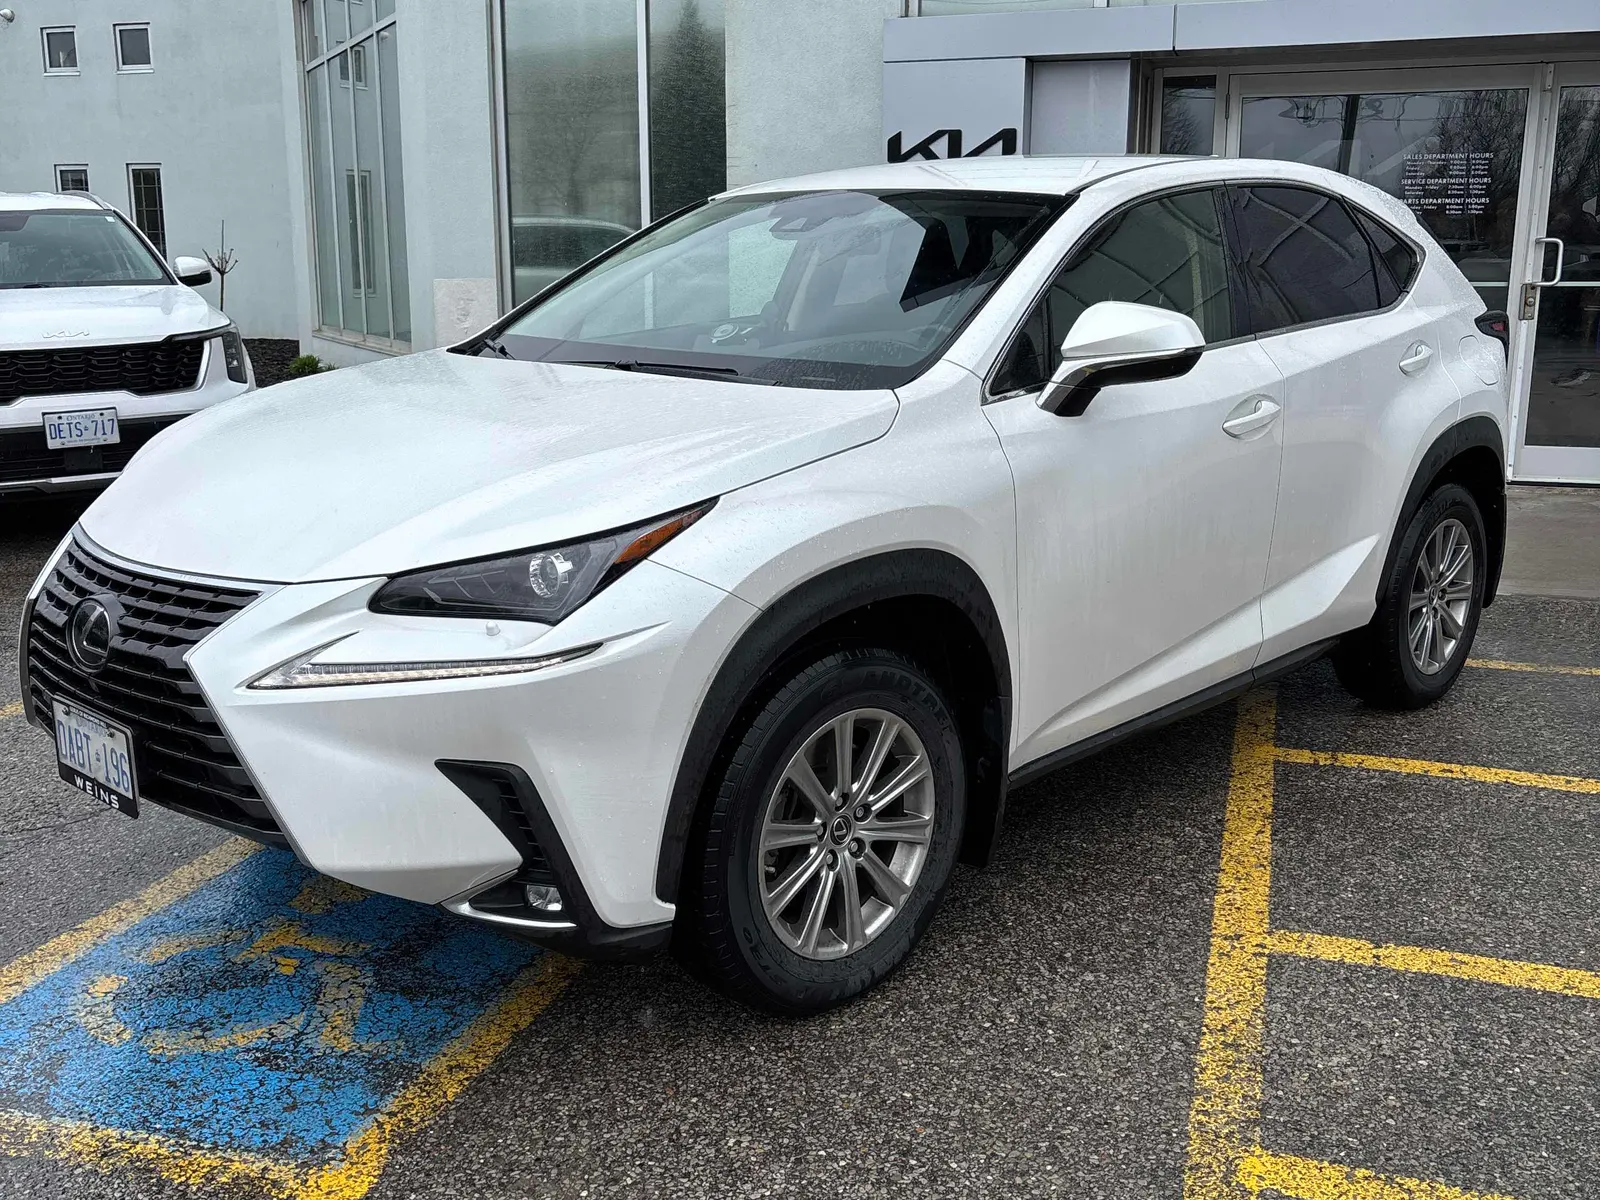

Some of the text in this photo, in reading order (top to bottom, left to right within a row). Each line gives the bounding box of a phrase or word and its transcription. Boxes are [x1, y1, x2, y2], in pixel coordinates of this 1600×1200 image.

[887, 128, 1017, 164] KIA
[48, 418, 115, 440] DETS 717
[66, 414, 96, 422] ONTARIO
[57, 719, 130, 793] DABT 196
